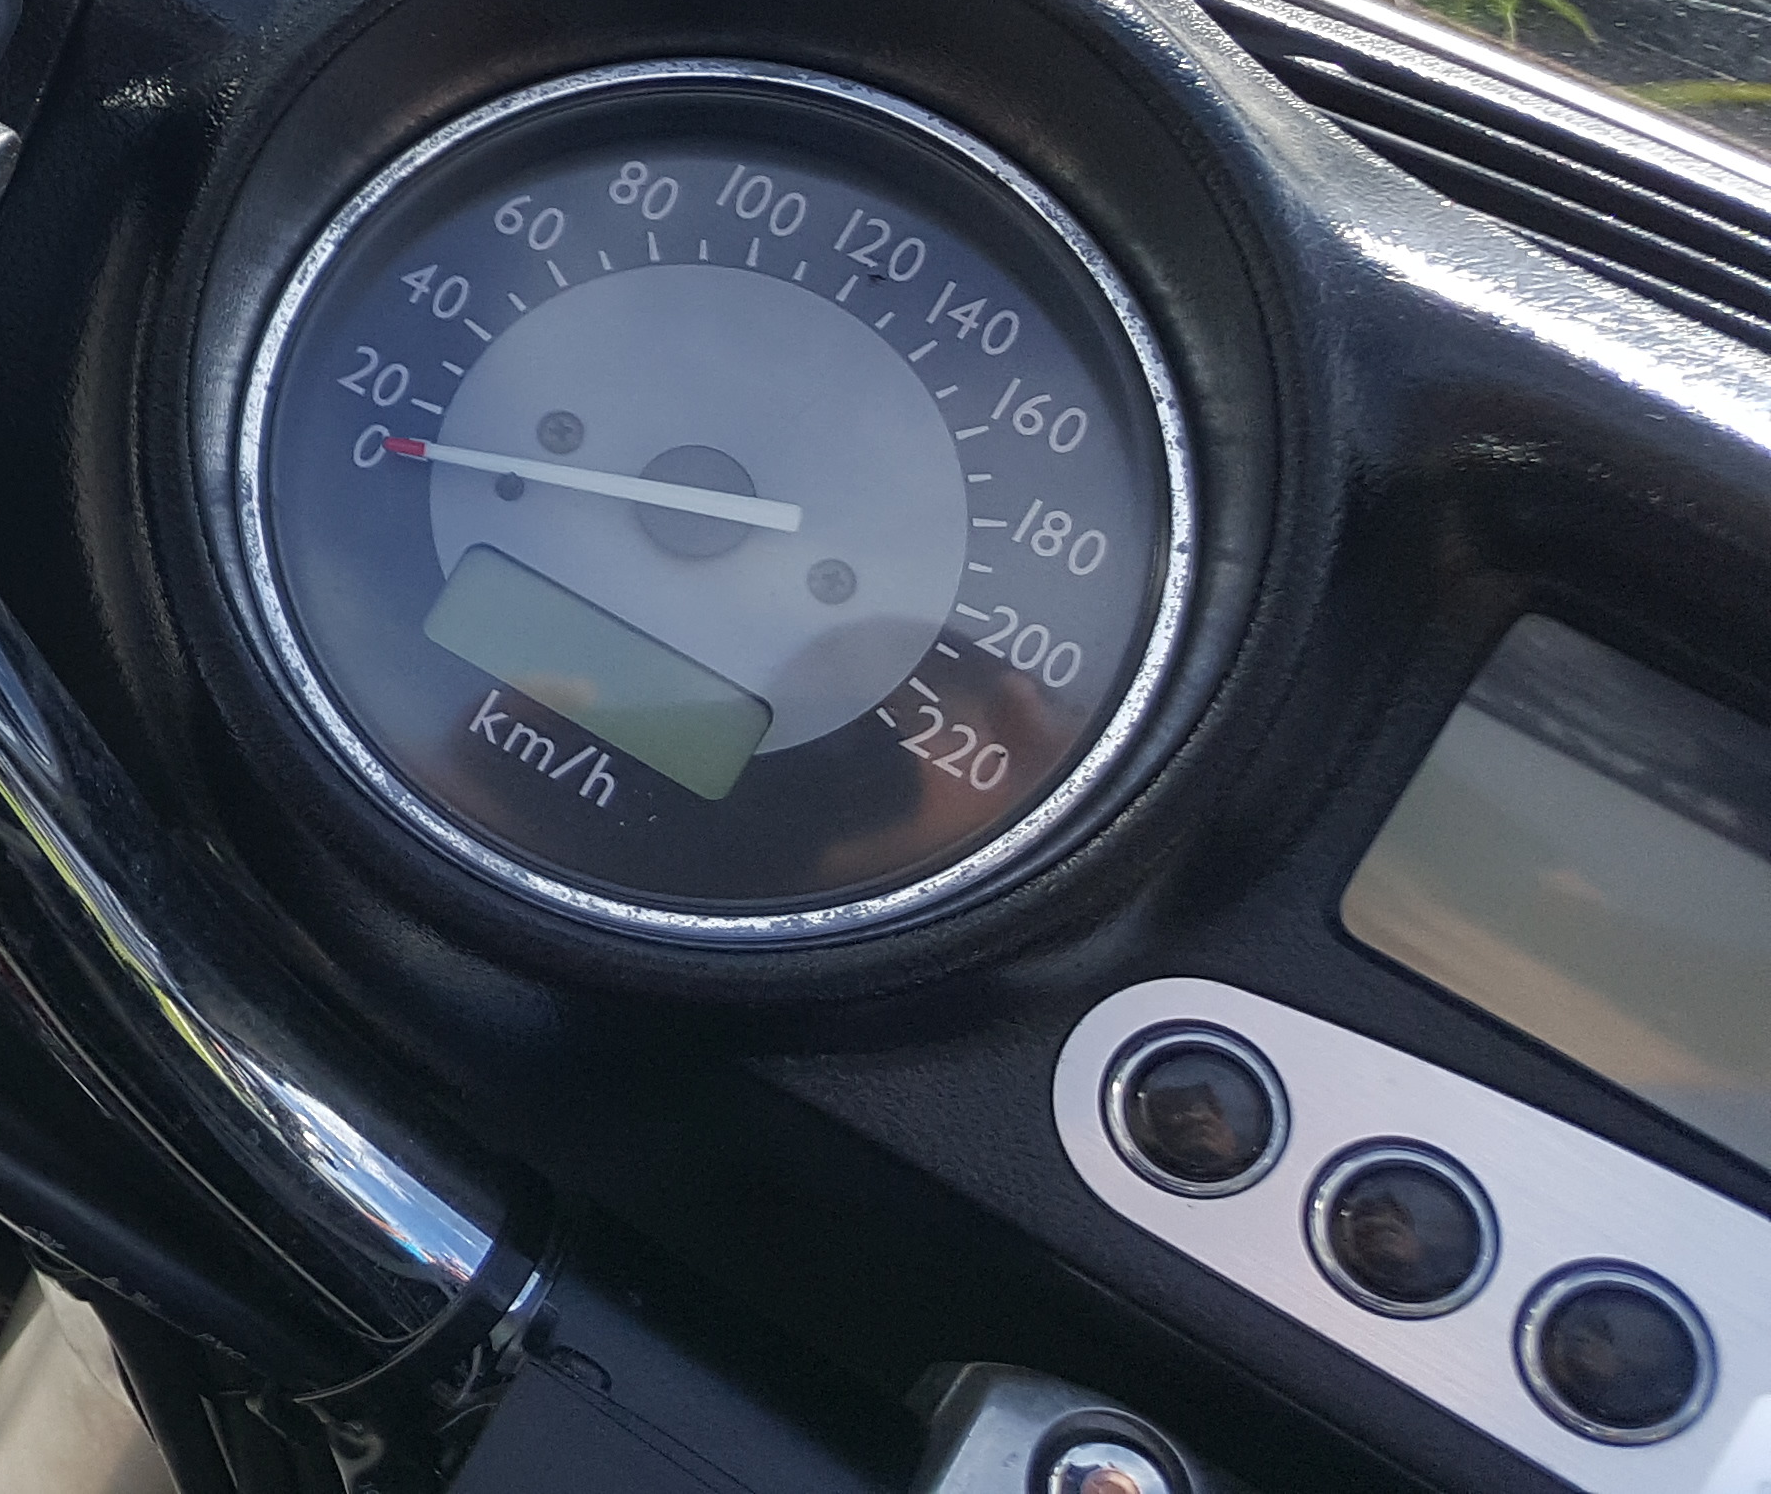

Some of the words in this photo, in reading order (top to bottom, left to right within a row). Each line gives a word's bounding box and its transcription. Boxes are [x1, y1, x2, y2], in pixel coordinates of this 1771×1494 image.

[493, 194, 565, 251] 60
[608, 159, 679, 221] 80
[715, 164, 807, 237] 100
[833, 208, 927, 281] 120
[400, 261, 472, 320] 40
[928, 280, 1019, 356] 140
[337, 344, 410, 407] 20
[352, 424, 389, 468] 0
[991, 377, 1088, 454] 160
[1010, 498, 1107, 576] 180
[973, 604, 1082, 688] 200
[469, 690, 619, 809] km/h
[899, 717, 1010, 793] 220
